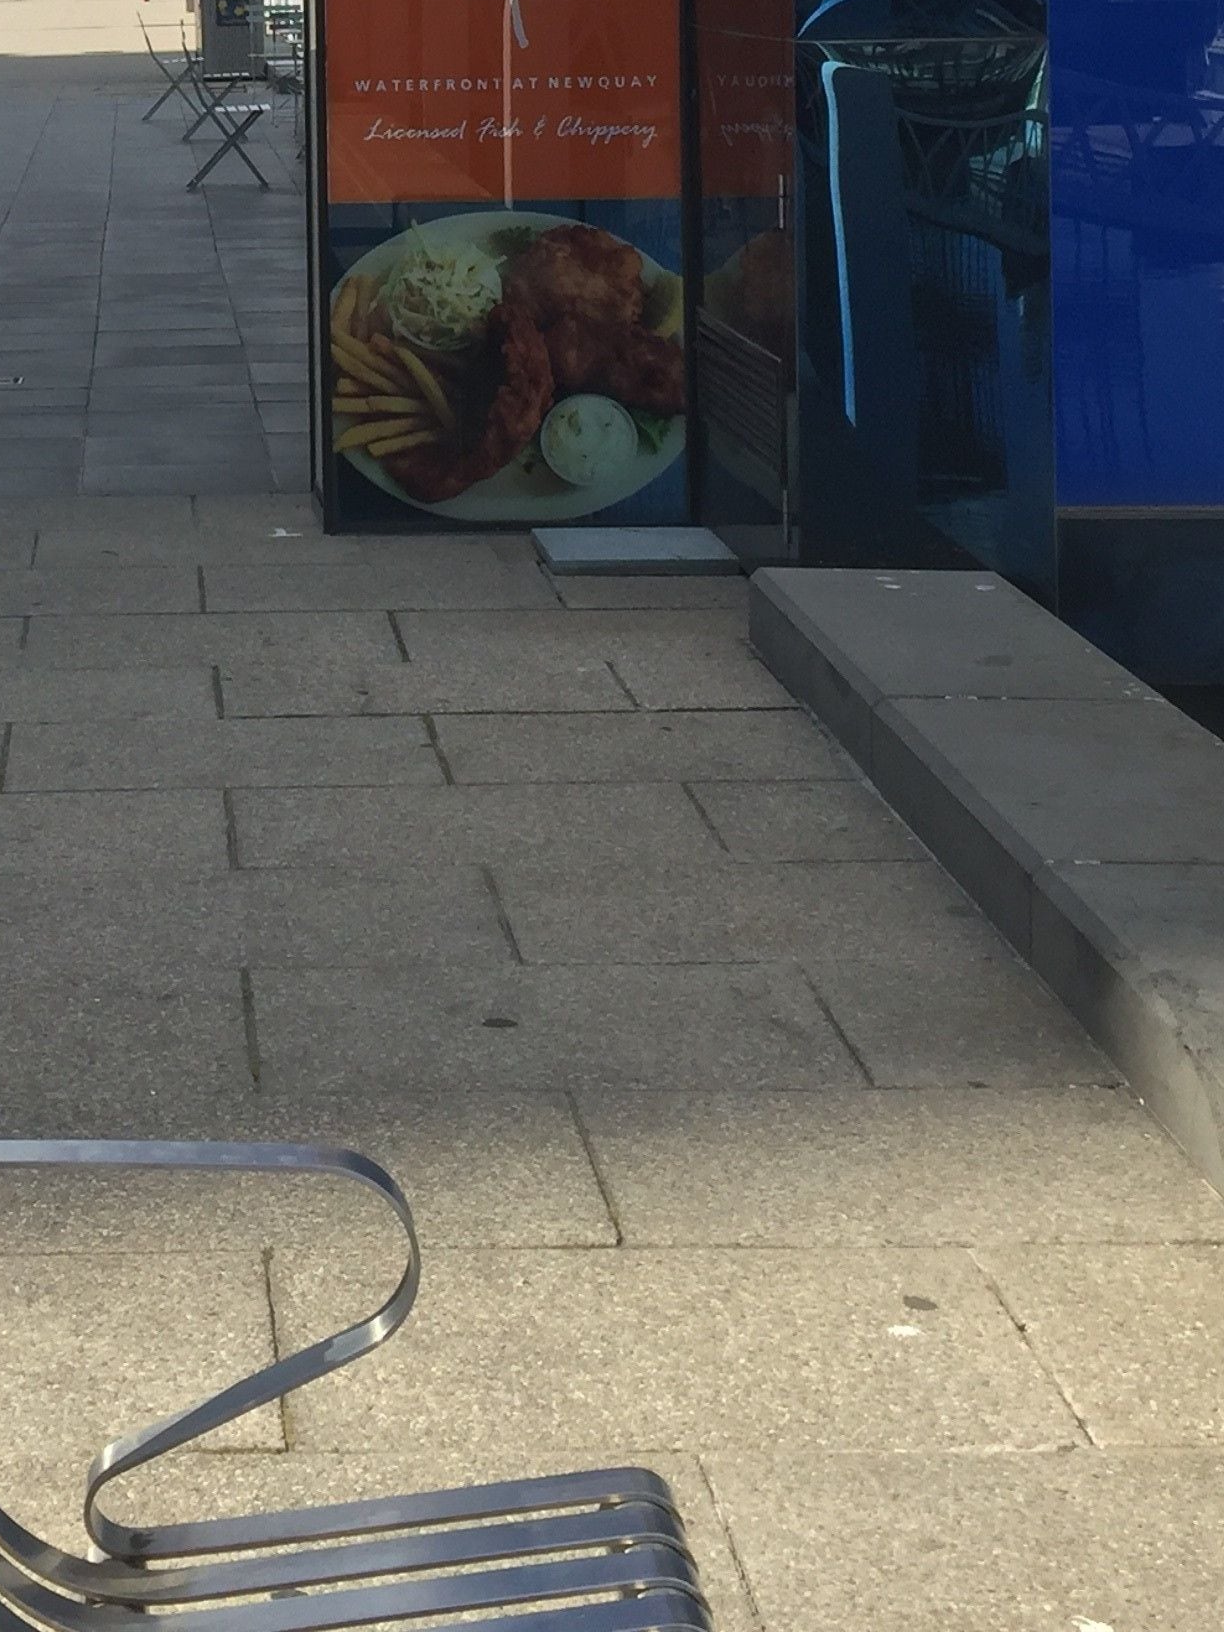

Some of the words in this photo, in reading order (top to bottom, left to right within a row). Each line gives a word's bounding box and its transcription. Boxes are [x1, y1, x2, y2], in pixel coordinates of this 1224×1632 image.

[354, 77, 502, 93] WATERFRONT
[512, 76, 539, 90] AT
[547, 74, 658, 90] NEWQUAY
[363, 118, 468, 142] Licensed
[476, 116, 524, 143] Fish
[556, 115, 658, 148] Chippery
